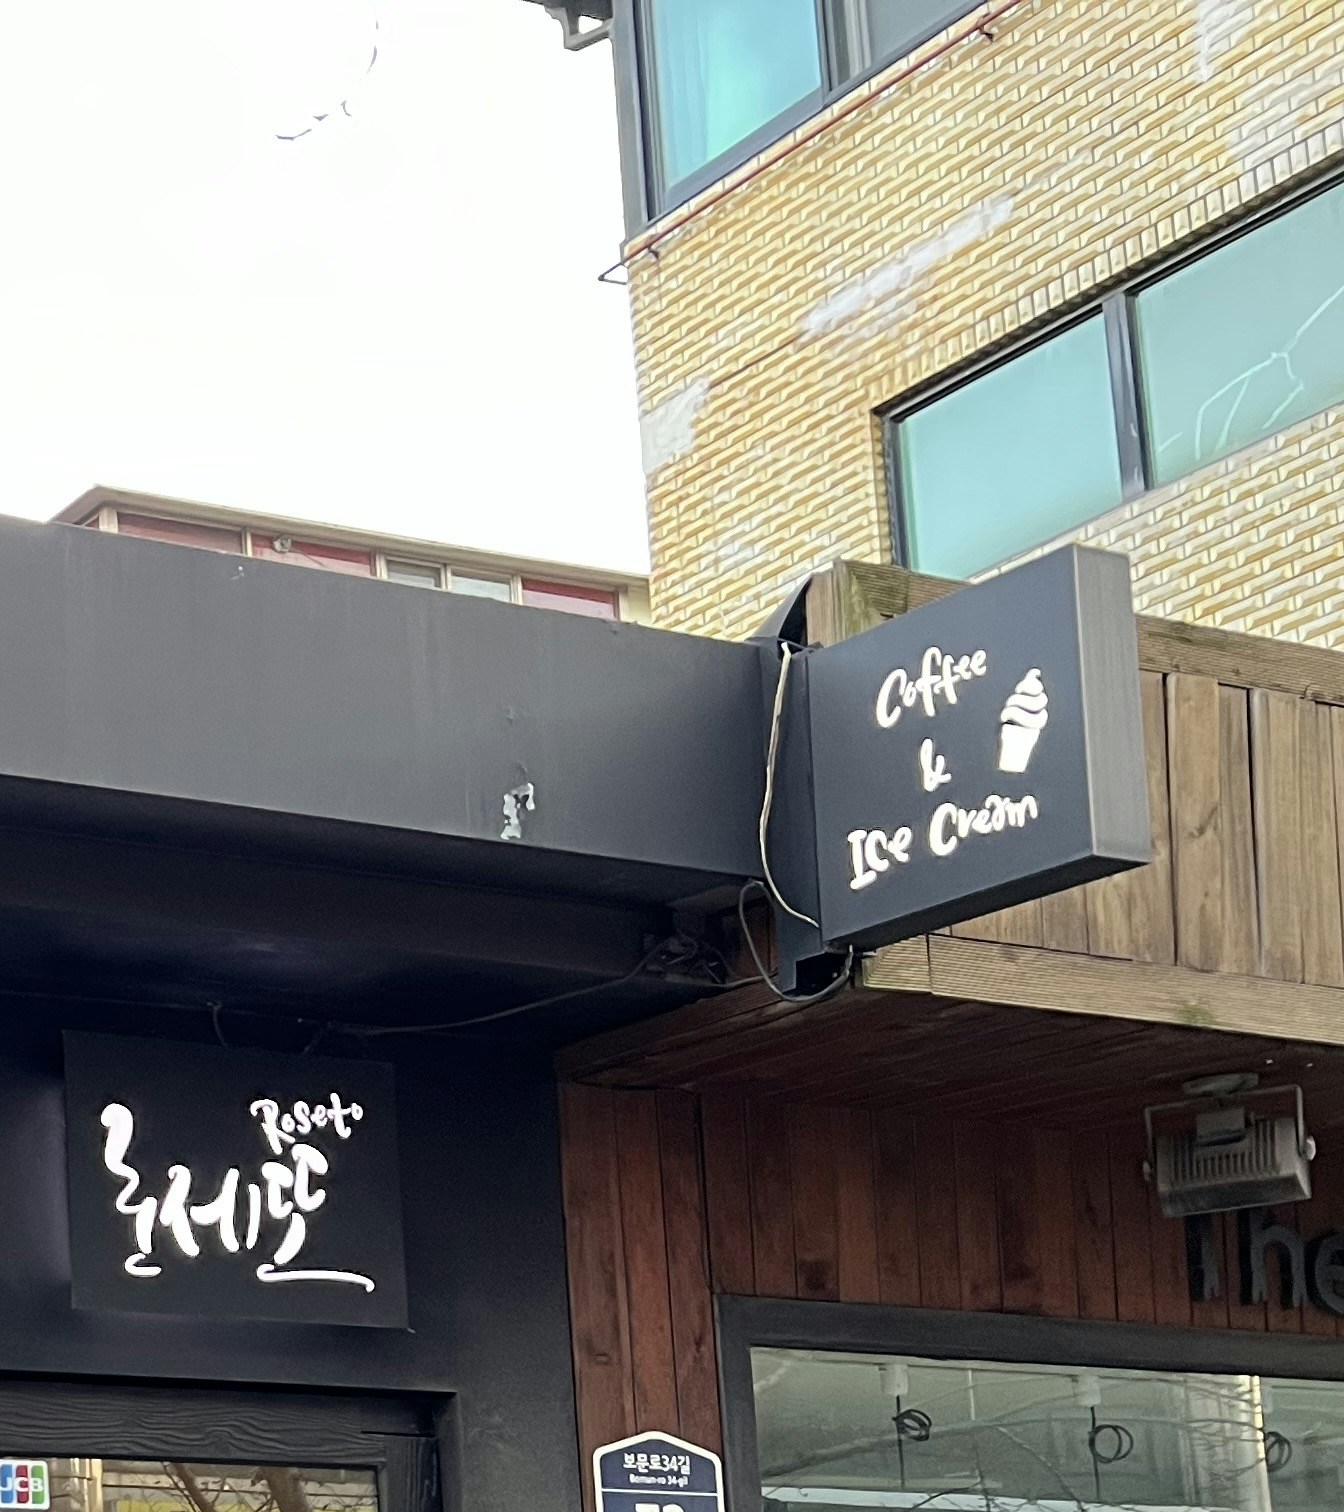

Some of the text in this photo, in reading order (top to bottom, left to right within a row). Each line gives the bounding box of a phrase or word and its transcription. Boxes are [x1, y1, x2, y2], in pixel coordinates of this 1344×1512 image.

[875, 646, 987, 728] Coffee
[920, 738, 952, 792] &
[847, 794, 1038, 890] Ice Cream
[250, 1092, 364, 1156] Roseto
[1, 1476, 44, 1493] JCB
[623, 1453, 691, 1475] 보문로34길
